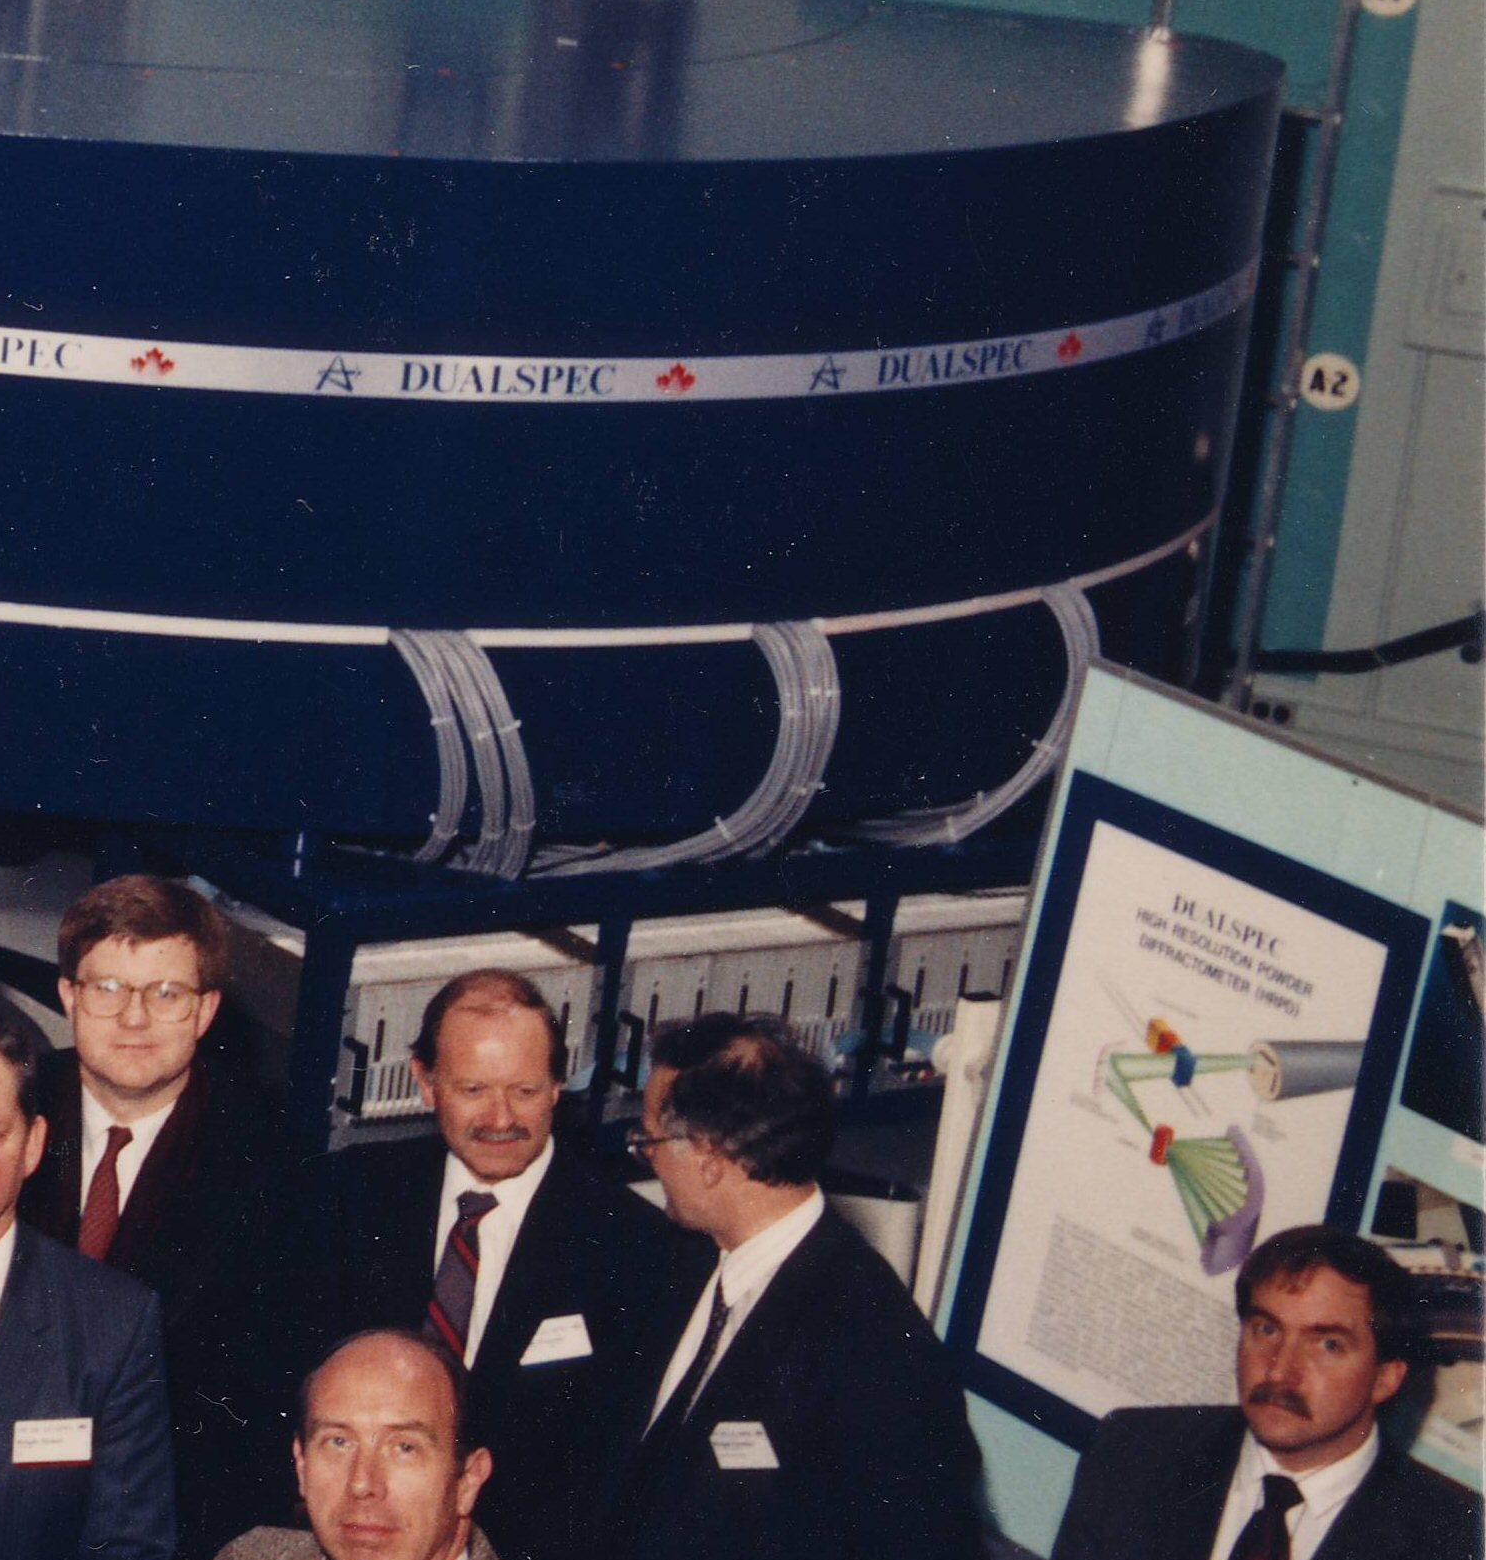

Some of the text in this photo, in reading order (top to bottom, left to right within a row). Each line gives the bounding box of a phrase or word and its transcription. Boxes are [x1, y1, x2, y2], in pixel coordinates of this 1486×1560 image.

[400, 360, 617, 396] DUALSPEC
[877, 340, 1033, 386] DUALSPEC
[1136, 906, 1314, 998] HIGH RESOLUTION POWDER
[1172, 893, 1286, 957] DUALSPEC
[1138, 932, 1301, 1019] DIFFRACTOMETER (HRPD)
